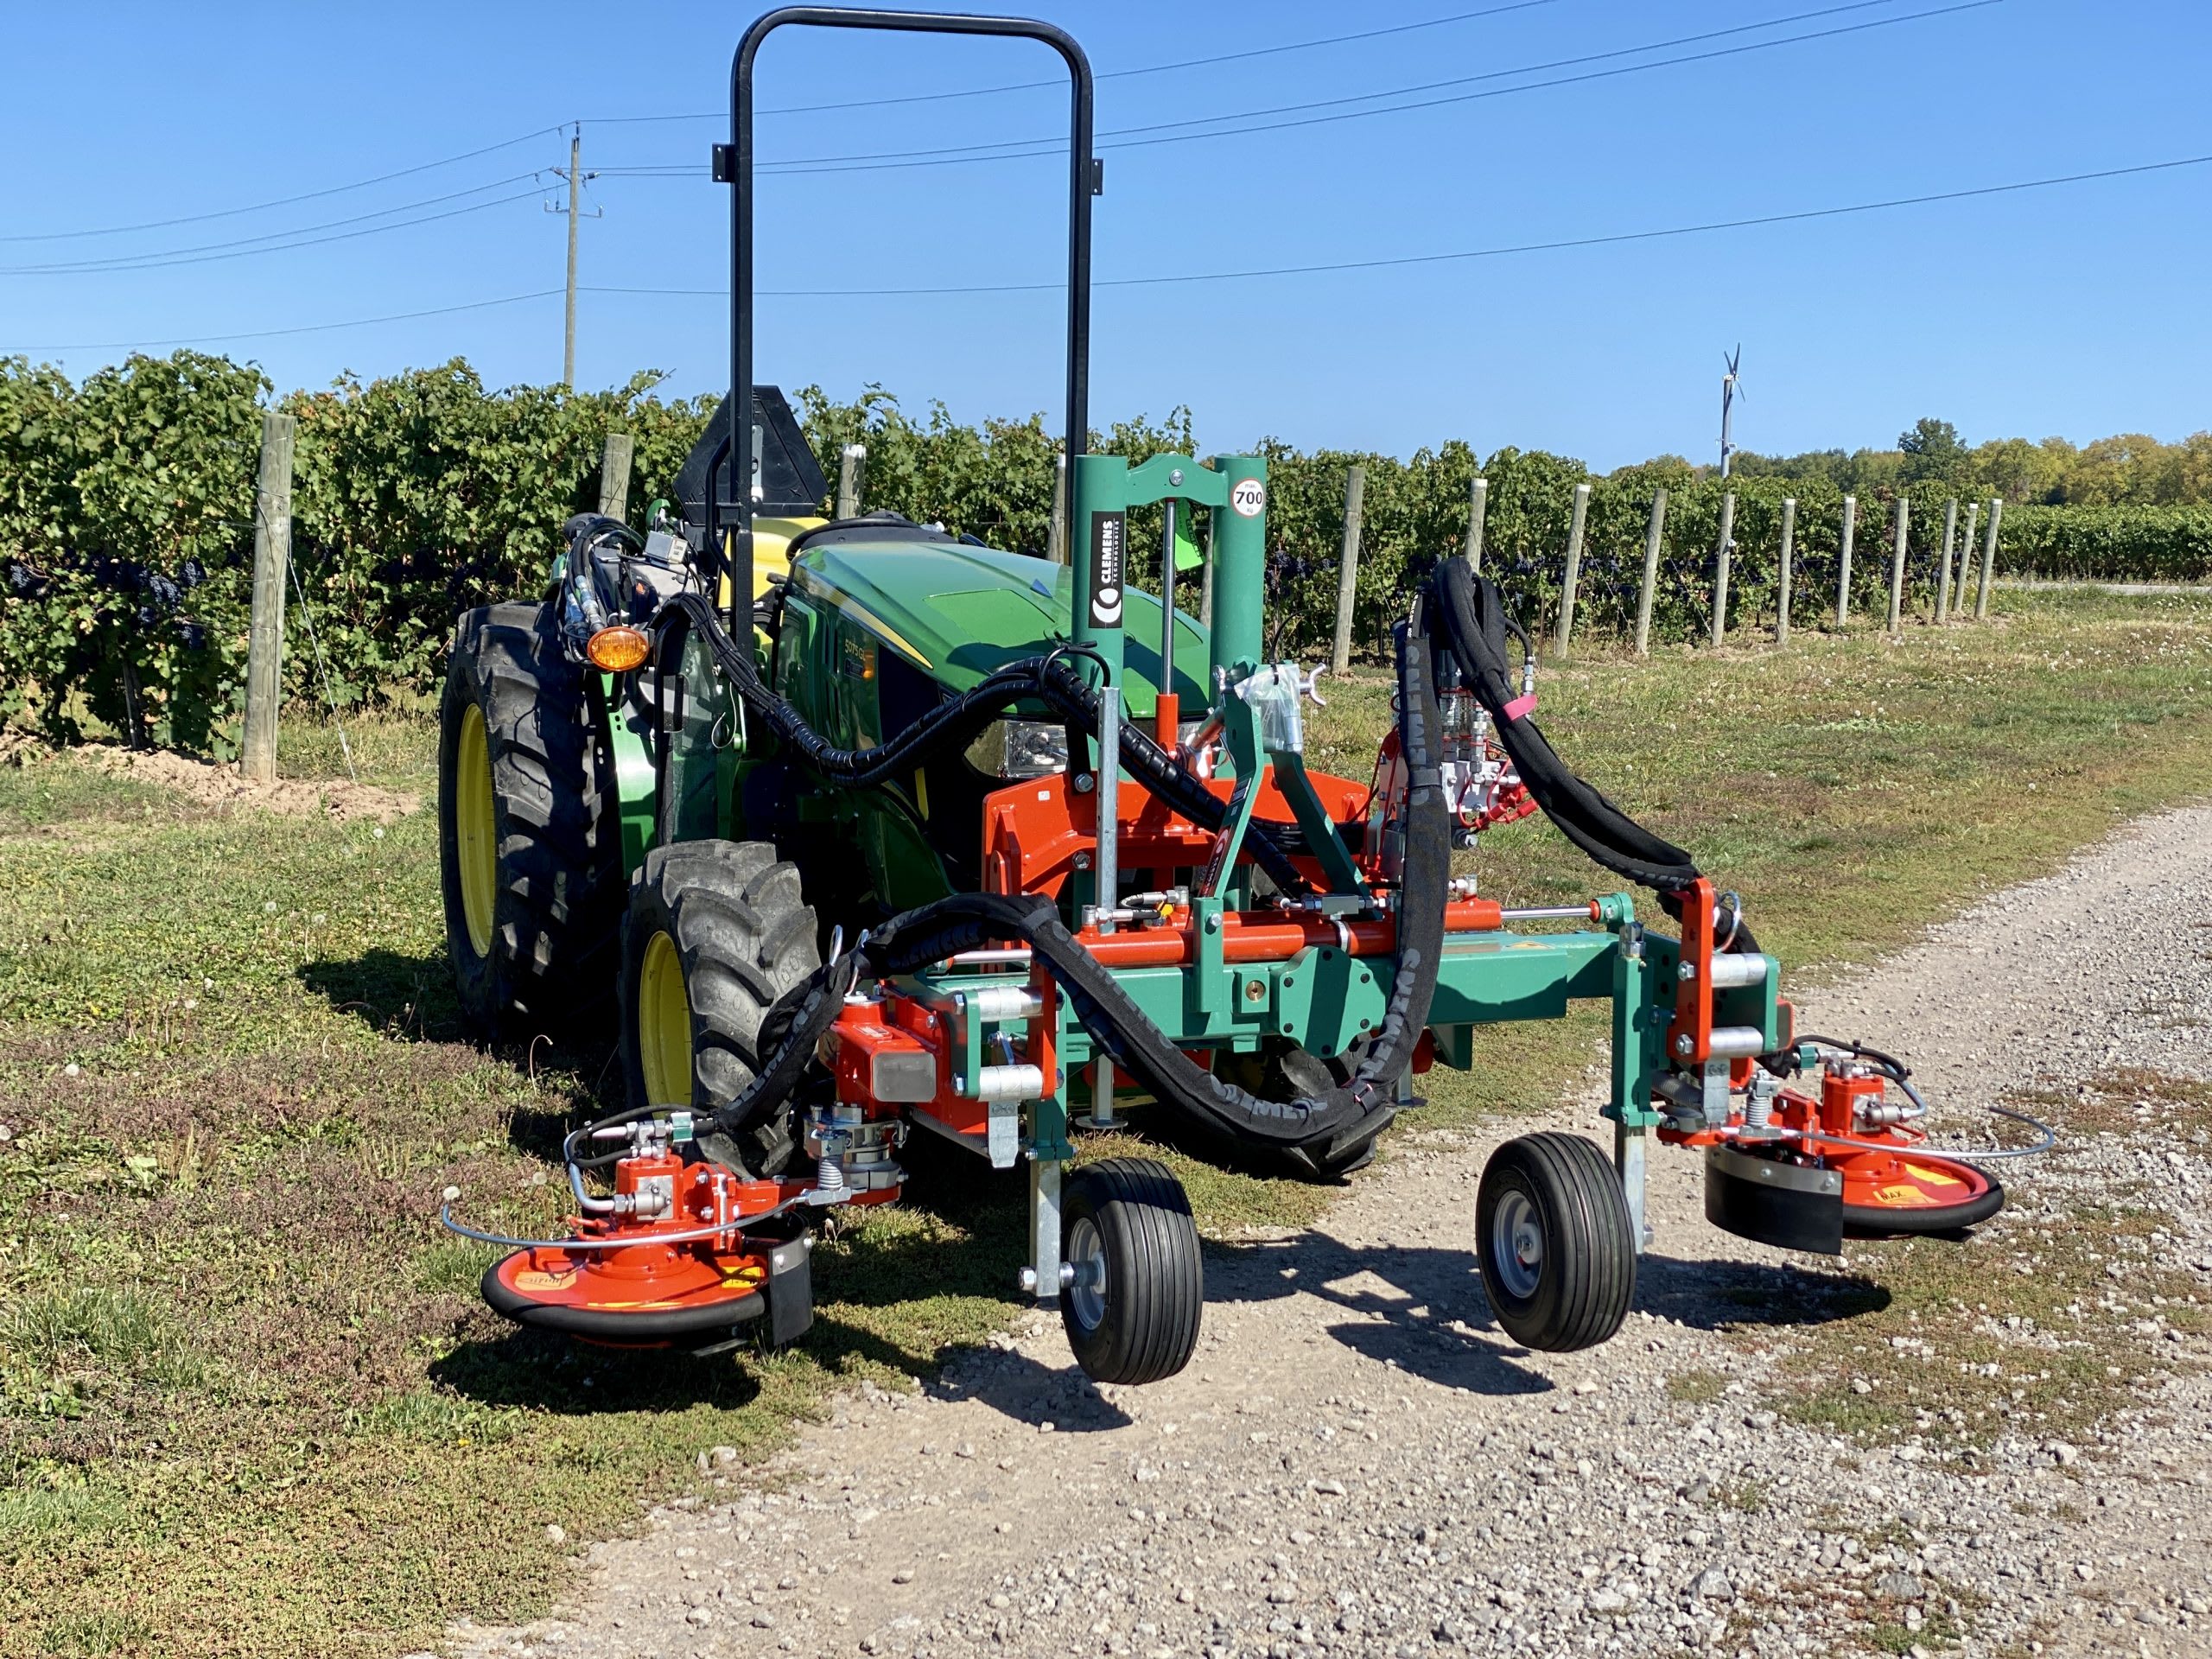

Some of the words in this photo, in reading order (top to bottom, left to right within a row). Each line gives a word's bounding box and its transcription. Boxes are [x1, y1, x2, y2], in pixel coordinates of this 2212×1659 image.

[1236, 491, 1262, 505] 700
[1101, 520, 1113, 584] CLEMENS
[1405, 645, 1430, 806] CEMENS
[1881, 1191, 1906, 1201] MAX.
